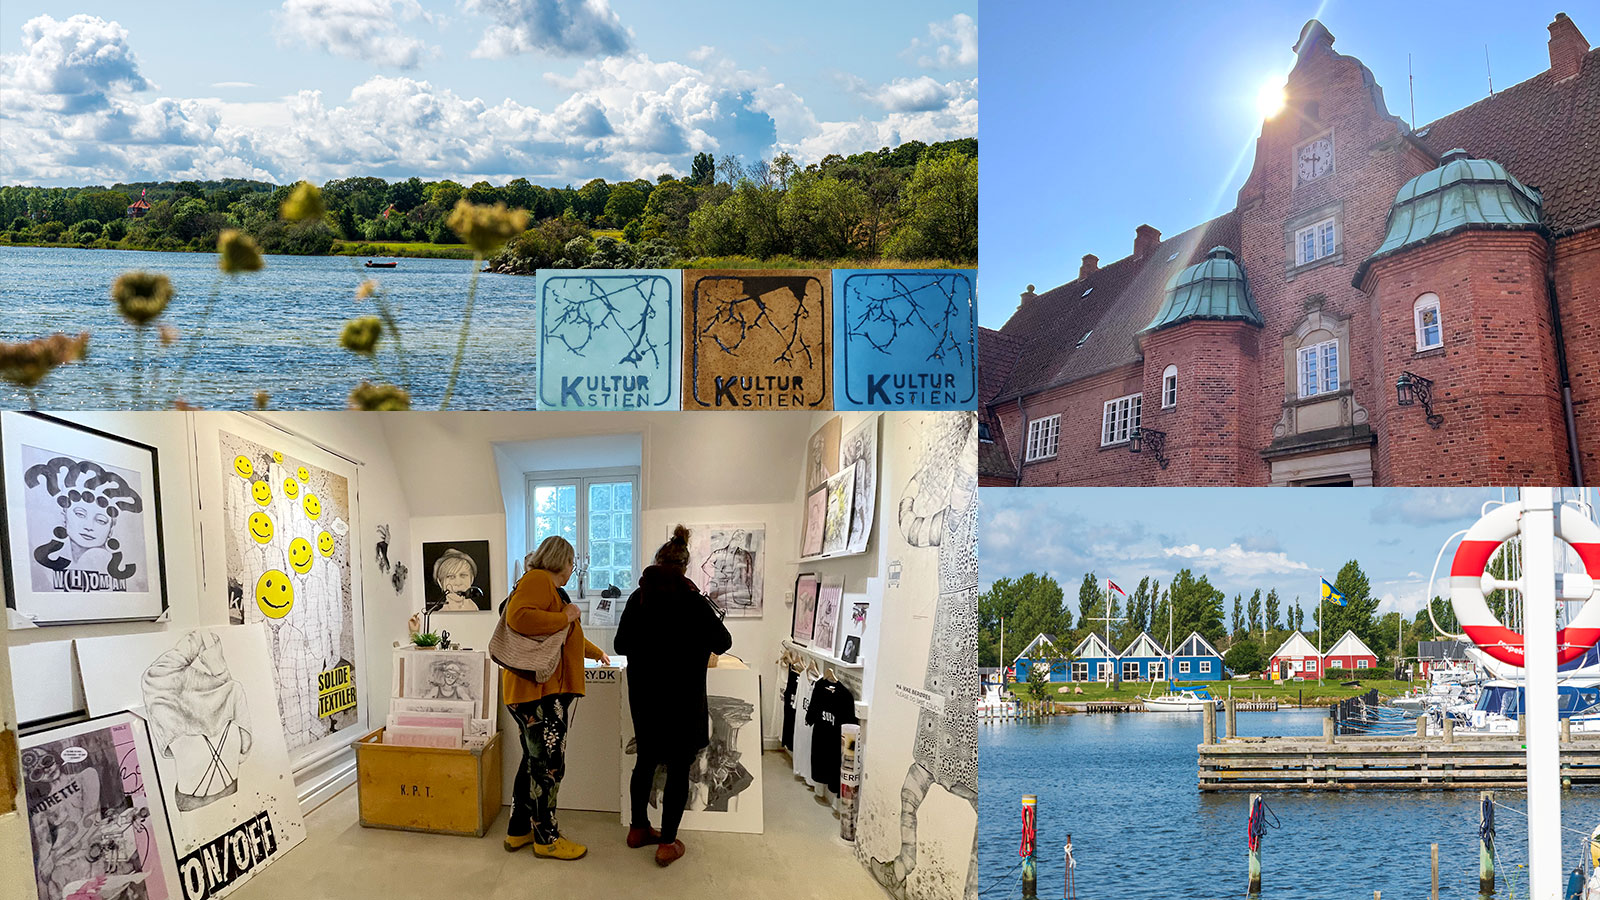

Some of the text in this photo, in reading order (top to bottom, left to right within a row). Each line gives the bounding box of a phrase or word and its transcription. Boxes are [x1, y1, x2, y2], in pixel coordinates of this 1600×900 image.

[561, 375, 649, 407] KULTUR
[588, 393, 649, 407] STIEN
[715, 375, 804, 407] KULTUR
[743, 394, 804, 407] STIEN
[867, 373, 956, 405] KULTUR
[895, 391, 956, 405] STIEN
[318, 667, 348, 691] SOLIDE
[319, 687, 356, 715] TEXTILER
[180, 816, 272, 900] ON/OFF
